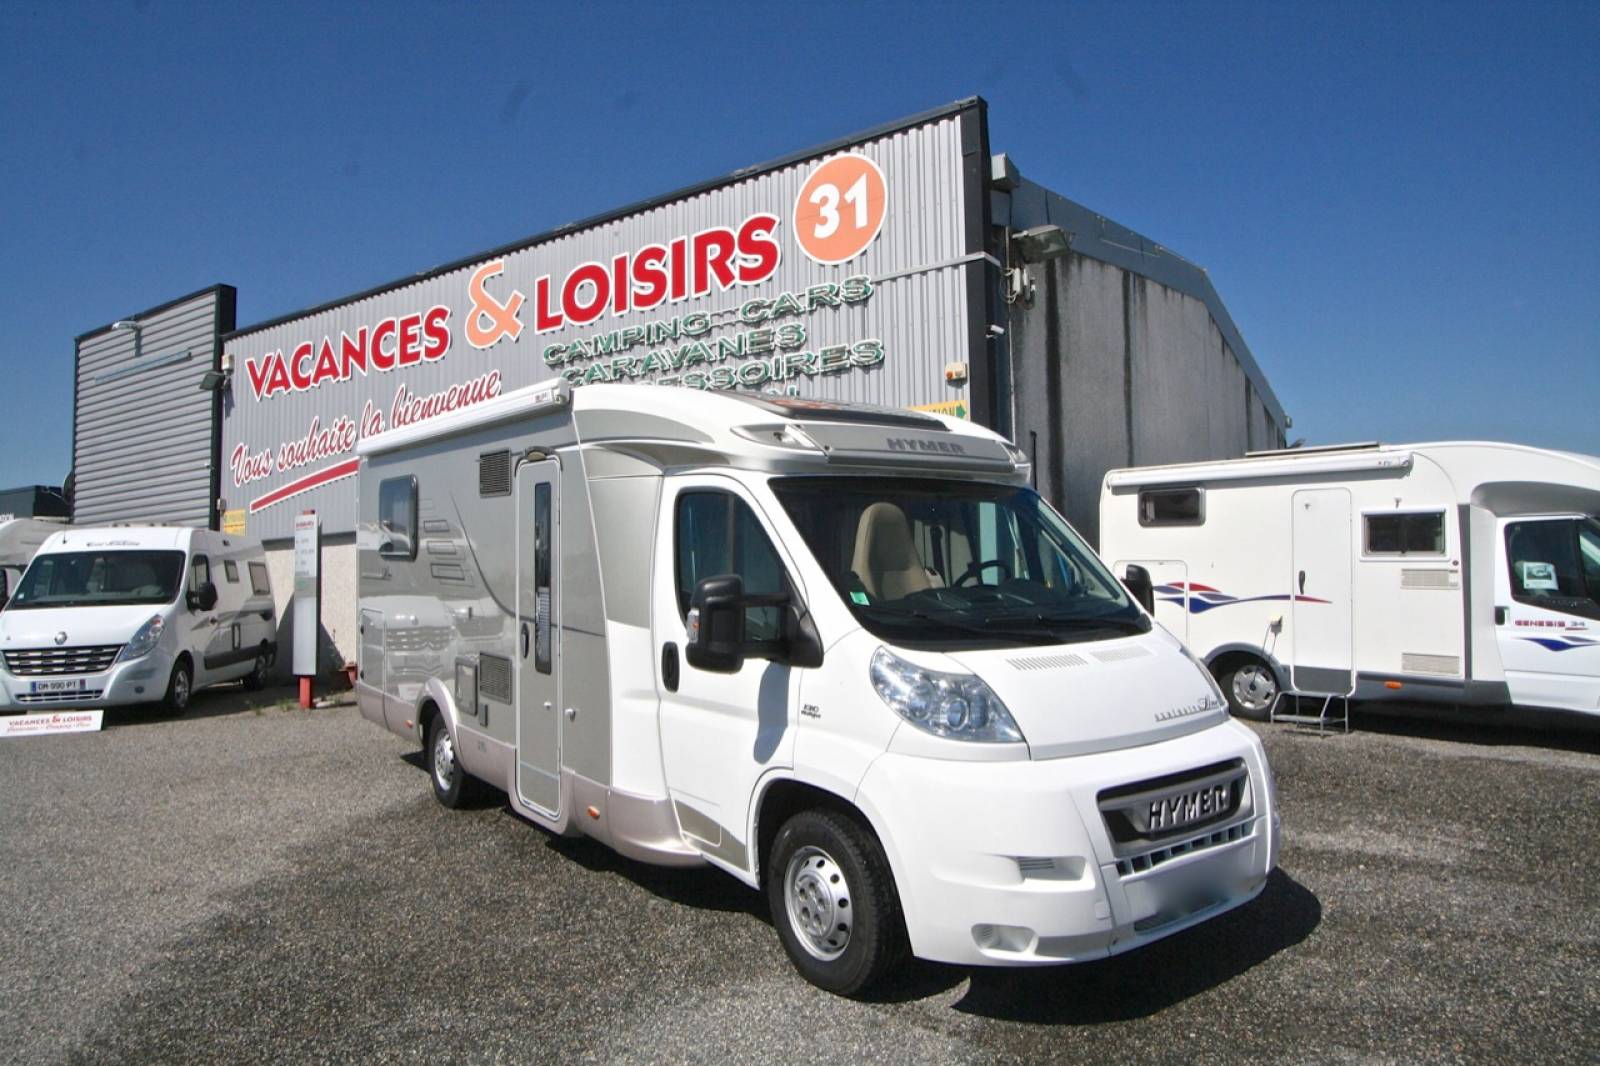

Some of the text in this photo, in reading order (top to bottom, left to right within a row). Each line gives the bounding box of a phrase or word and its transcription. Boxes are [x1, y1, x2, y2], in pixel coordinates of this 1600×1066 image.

[809, 173, 869, 239] 31
[246, 212, 781, 401] VACANCES & LOISIRS
[543, 274, 875, 366] CAMPING CARS
[560, 322, 807, 387] CARAVANES
[231, 369, 500, 488] Vous souhaite la bienvenue
[886, 438, 966, 455] HYMER
[1514, 619, 1566, 628] GENESIS
[1149, 785, 1229, 830] HYMER
